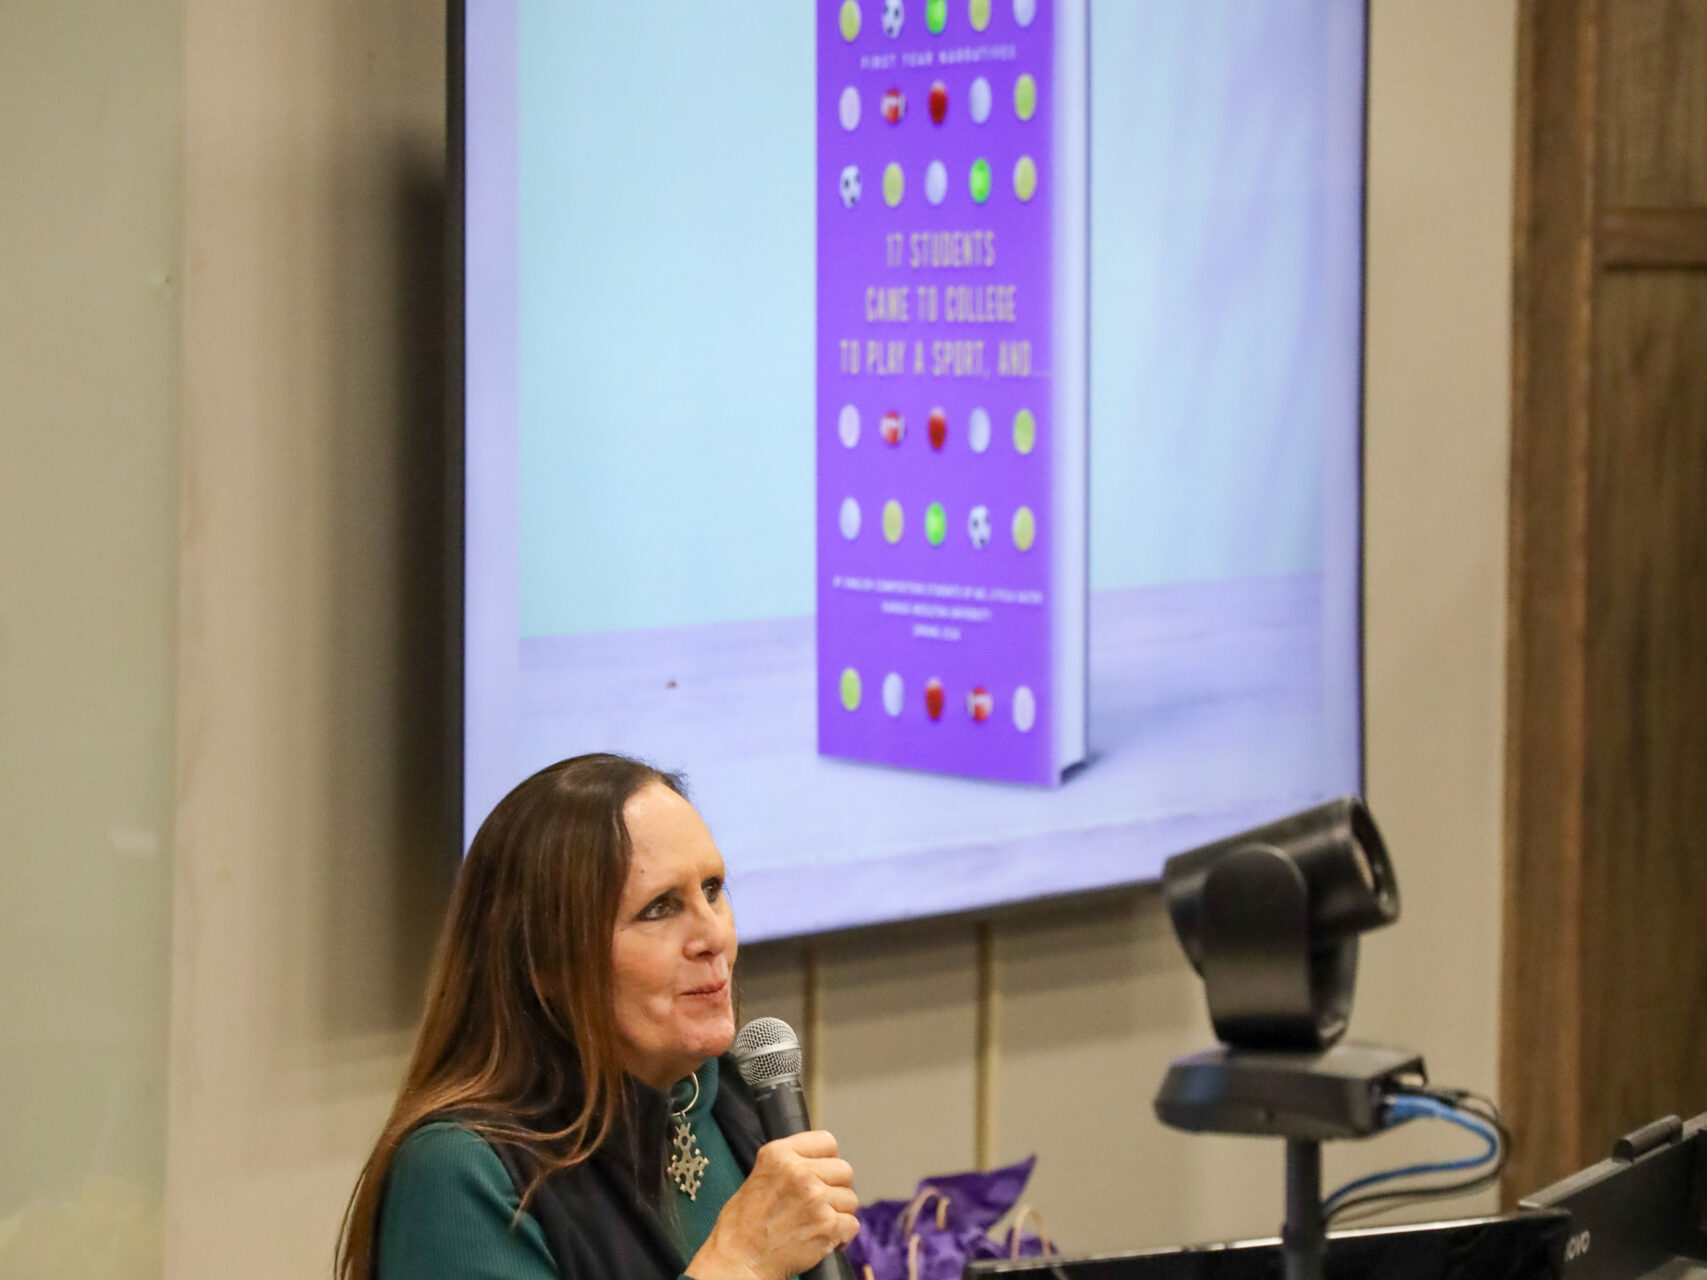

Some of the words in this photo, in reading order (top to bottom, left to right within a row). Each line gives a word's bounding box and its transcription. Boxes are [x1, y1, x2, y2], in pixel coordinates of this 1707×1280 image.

[886, 232, 904, 268] 17
[910, 230, 995, 268] STUDENTS
[865, 286, 909, 322] CAME
[917, 286, 939, 322] TO
[945, 285, 1016, 322] COLLEGE
[840, 339, 861, 375] TO
[866, 340, 906, 375] PLAY
[913, 341, 925, 375] A
[1564, 1230, 1591, 1262] ovo
